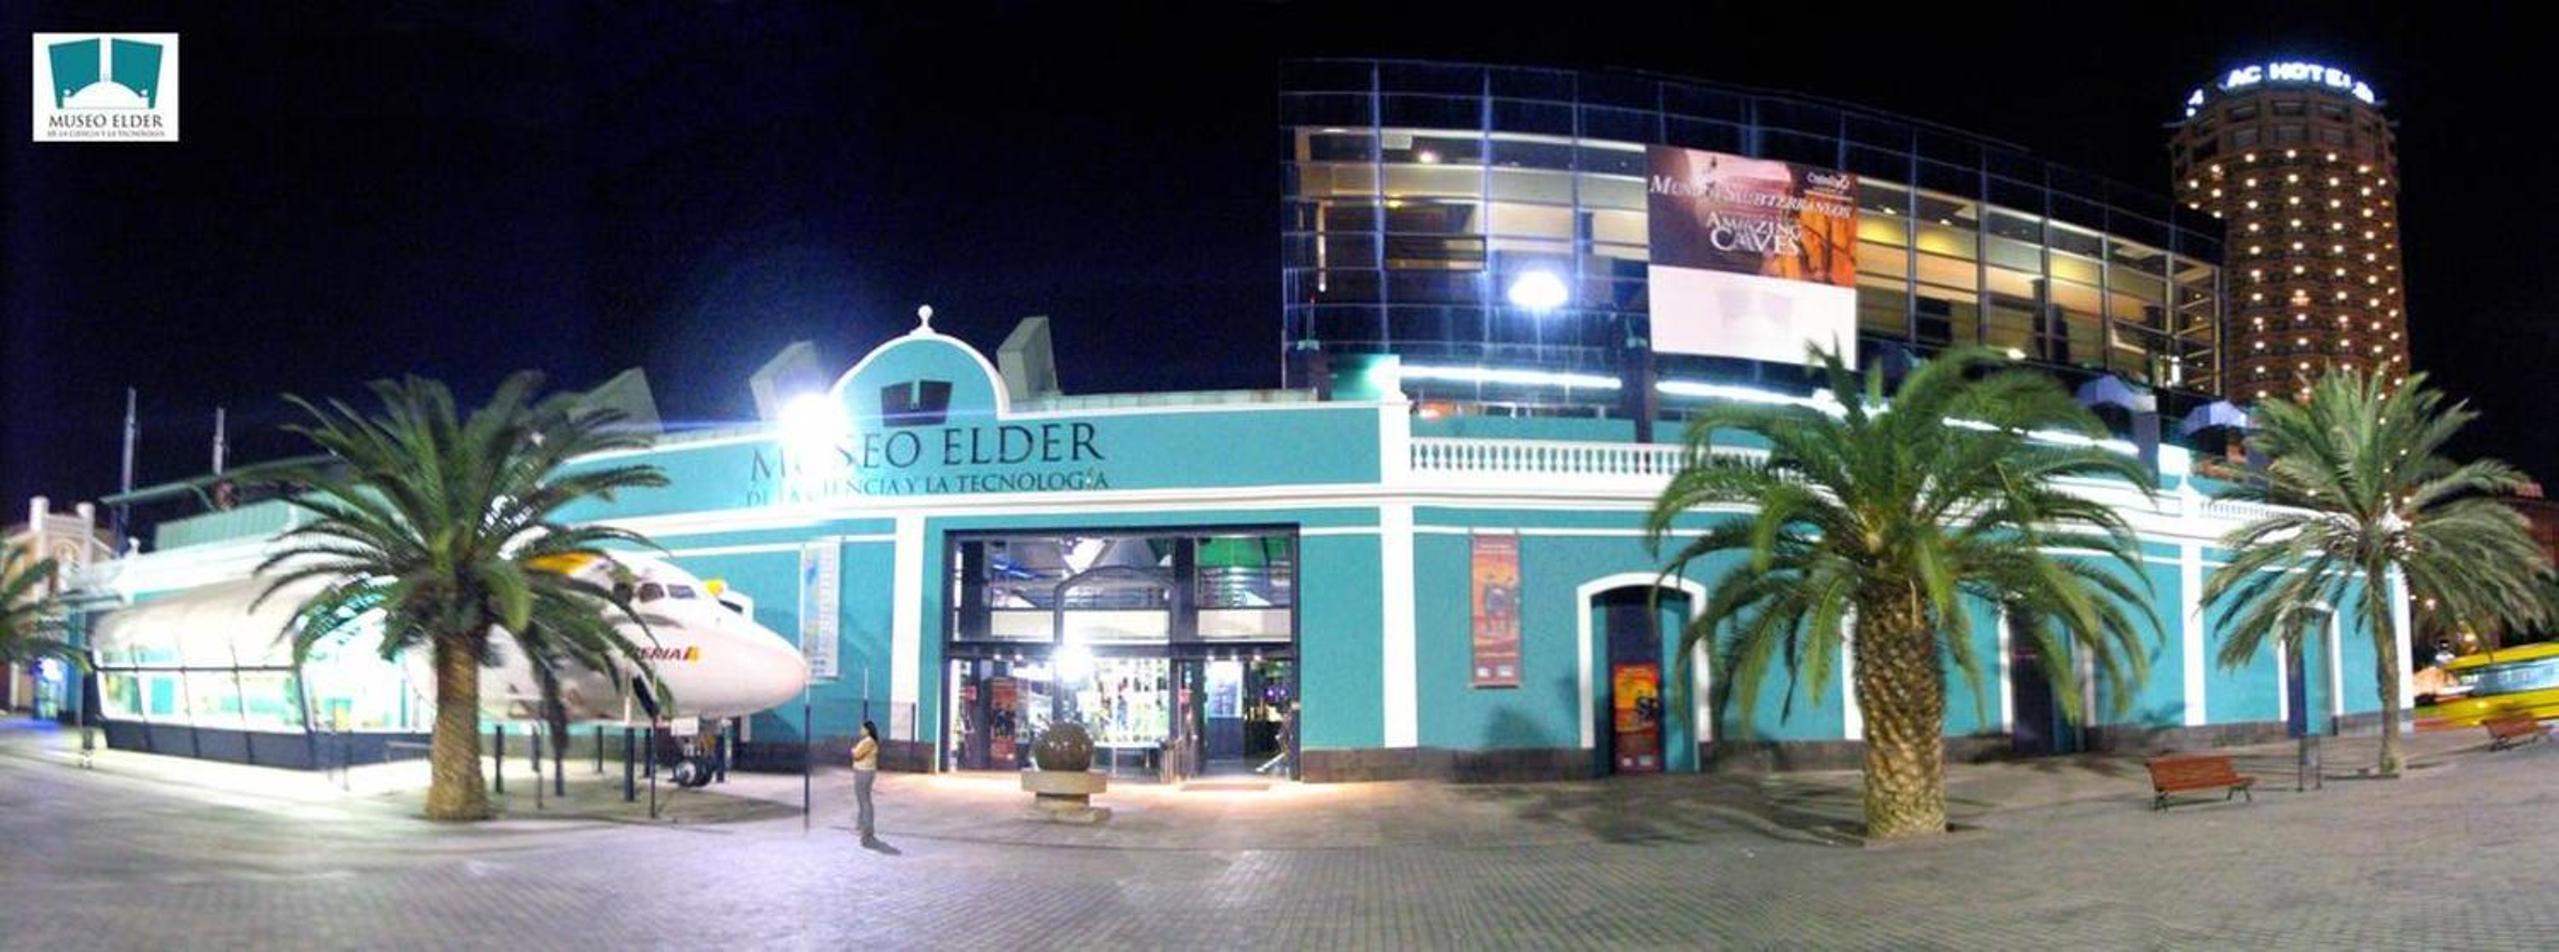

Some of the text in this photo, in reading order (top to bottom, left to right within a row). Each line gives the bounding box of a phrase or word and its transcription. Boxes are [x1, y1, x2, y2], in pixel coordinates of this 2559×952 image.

[2227, 65, 2262, 88] AC
[1709, 228, 1800, 256] CAVES
[751, 422, 1105, 481] MSEO ELDER
[805, 477, 900, 502] INCIA
[926, 474, 949, 494] LA
